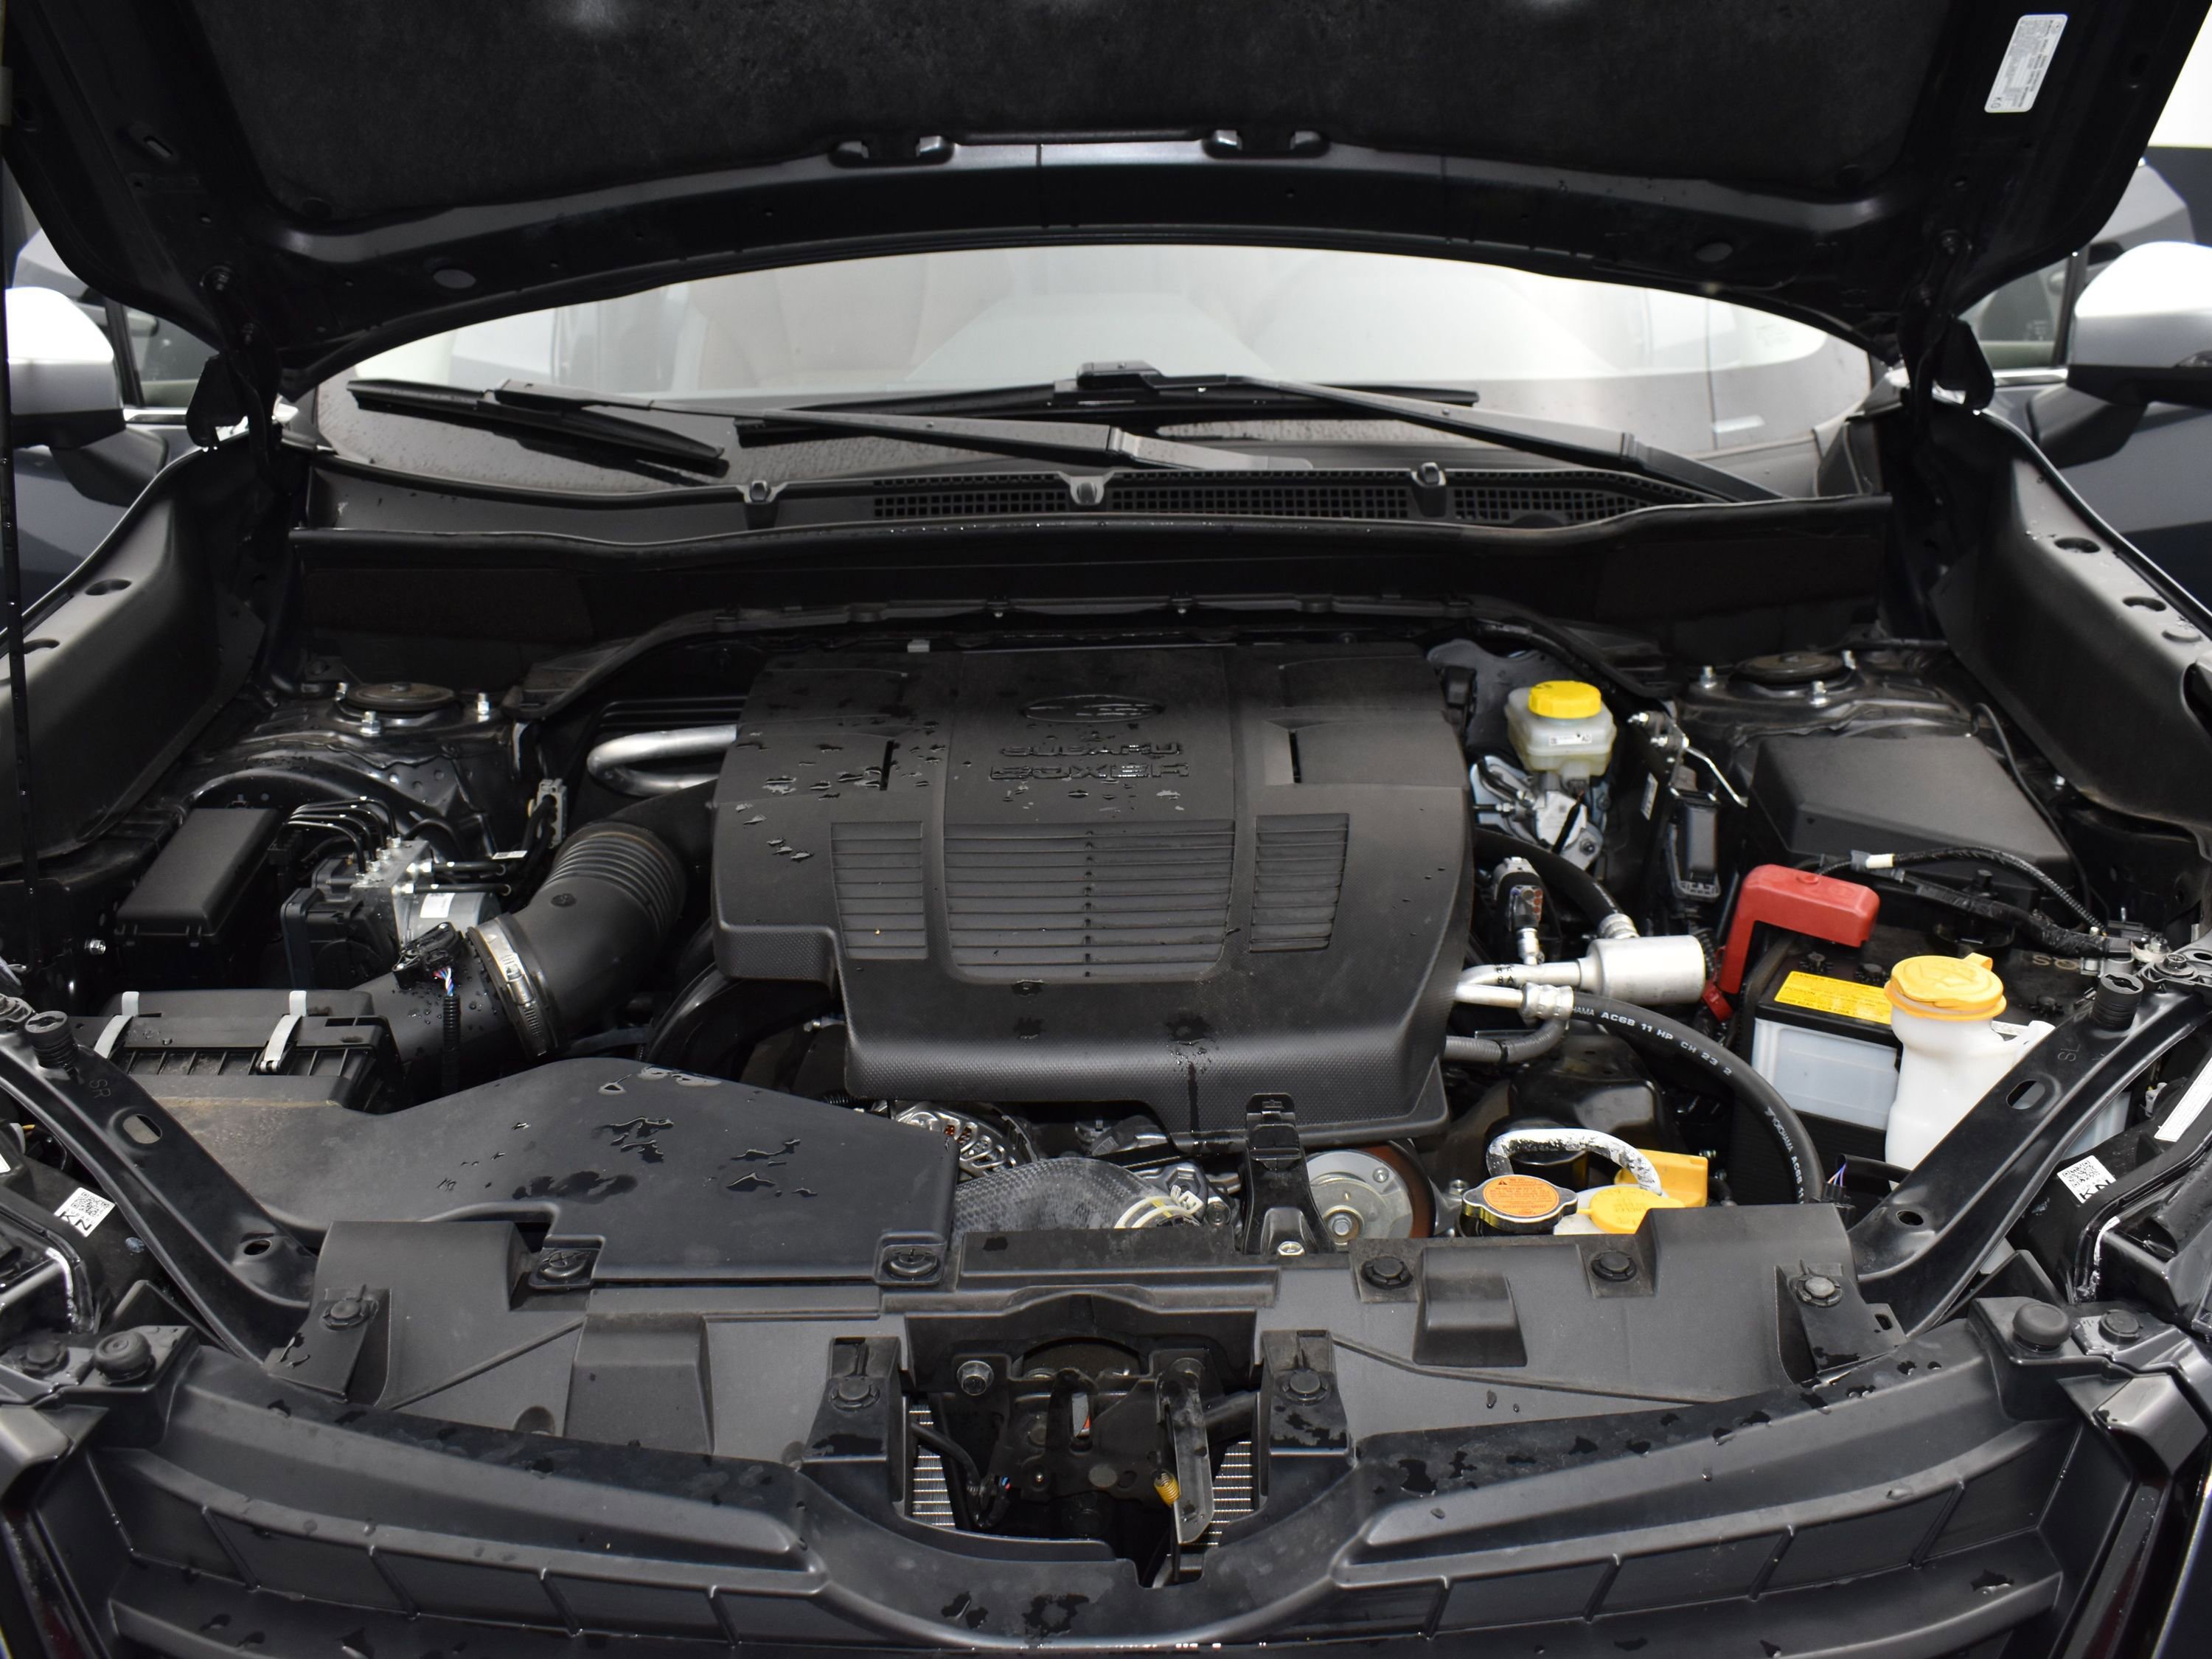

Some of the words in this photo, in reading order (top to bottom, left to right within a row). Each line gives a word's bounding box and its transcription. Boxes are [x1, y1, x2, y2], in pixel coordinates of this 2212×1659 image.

[1001, 742, 1183, 757] SUBARU
[990, 762, 1190, 780] BOXER
[1641, 1023, 1652, 1032] 11
[1656, 1029, 1674, 1040] HP
[1680, 1040, 1697, 1054] CH
[1700, 1051, 1719, 1066] 23
[88, 1079, 111, 1099] SR
[1771, 1116, 1794, 1152] YOKOHAMA
